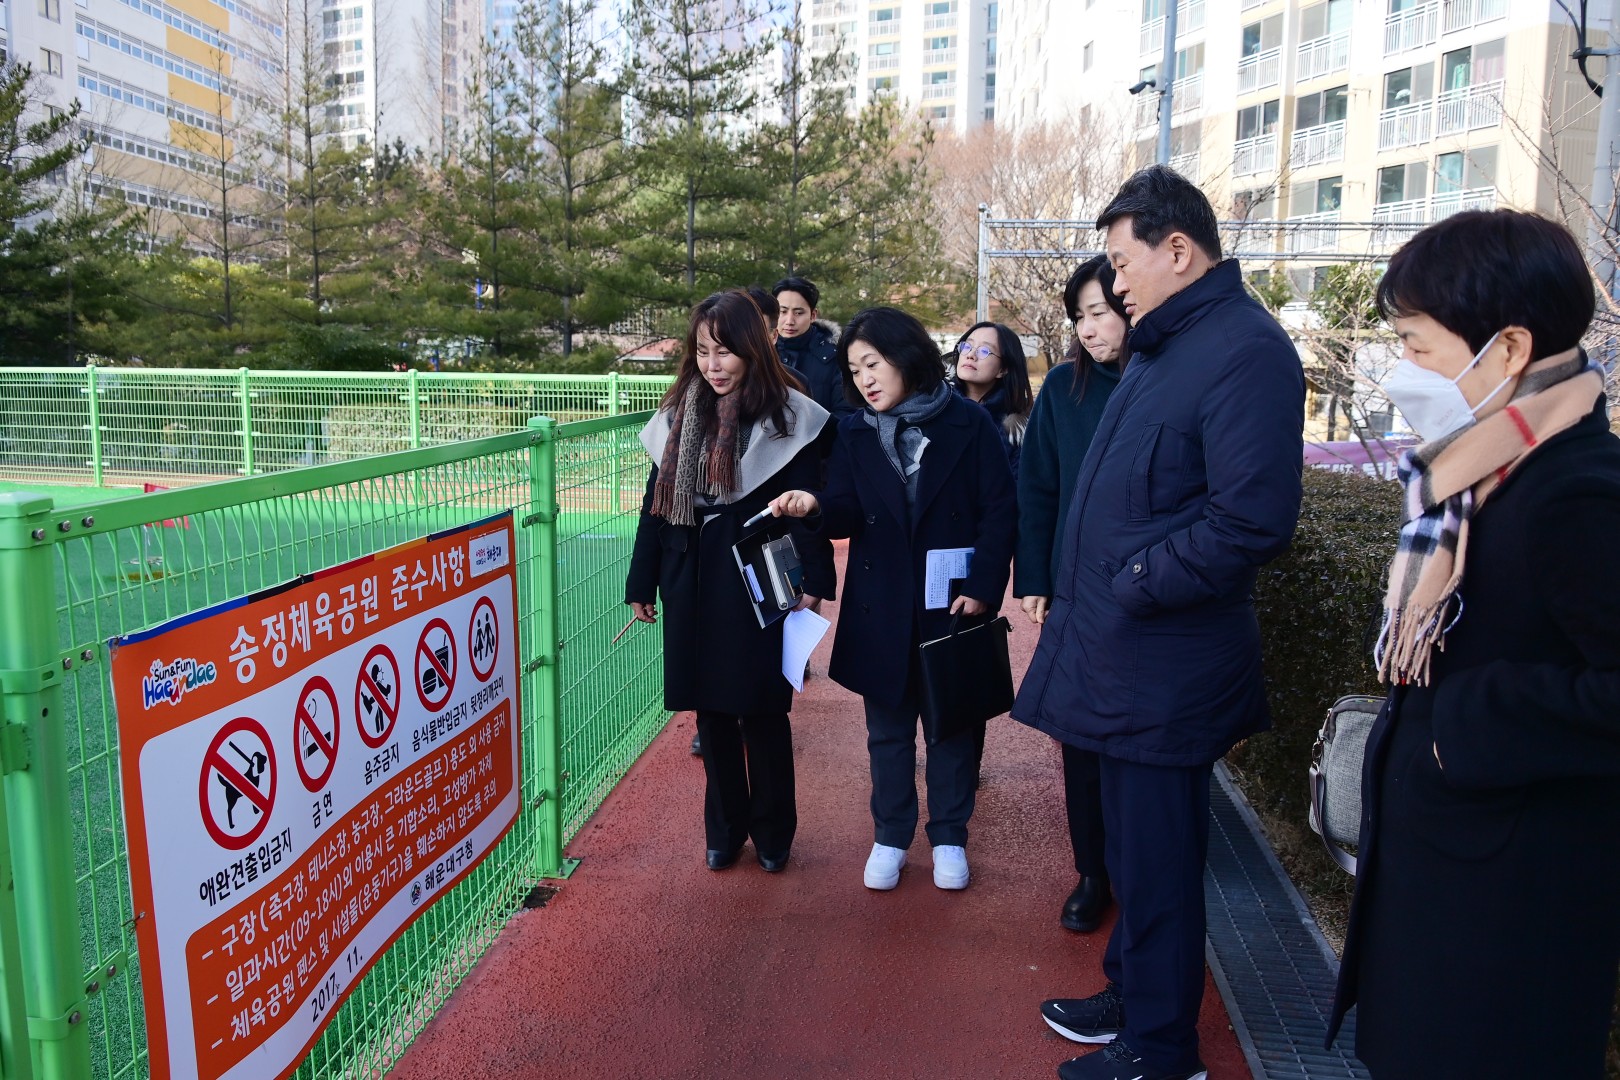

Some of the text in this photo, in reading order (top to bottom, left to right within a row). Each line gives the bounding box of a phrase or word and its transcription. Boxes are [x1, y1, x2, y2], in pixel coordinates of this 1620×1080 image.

[228, 545, 465, 684] 송정체육공원 준수사항
[153, 660, 192, 683] Sun&Fun
[470, 674, 505, 716] 뒷정리깨끗이
[411, 700, 468, 753] 음식물반입금지
[364, 741, 400, 786] 음주금지
[308, 828, 351, 882] 테니스장,
[352, 800, 383, 845] 농구장,
[469, 733, 477, 755] 외
[478, 722, 492, 747] 사용
[493, 710, 506, 738] 금지
[312, 790, 333, 829] 금연
[355, 834, 383, 875] 이용시
[385, 825, 395, 852] 큰
[397, 794, 440, 837] 기합소리,
[442, 765, 476, 806] 고성방가
[478, 752, 493, 777] 자제
[199, 827, 292, 907] 애완견출입금지
[424, 838, 473, 891] 해운대구청
[230, 969, 296, 1042] 체육공원
[296, 946, 318, 988] 펜스
[319, 928, 330, 960] 및
[331, 845, 413, 941] 시설물(운동기구)을
[416, 812, 456, 859] 훼손하지
[457, 791, 482, 829] 않도록
[483, 777, 497, 805] 주의
[346, 945, 363, 974] 11.
